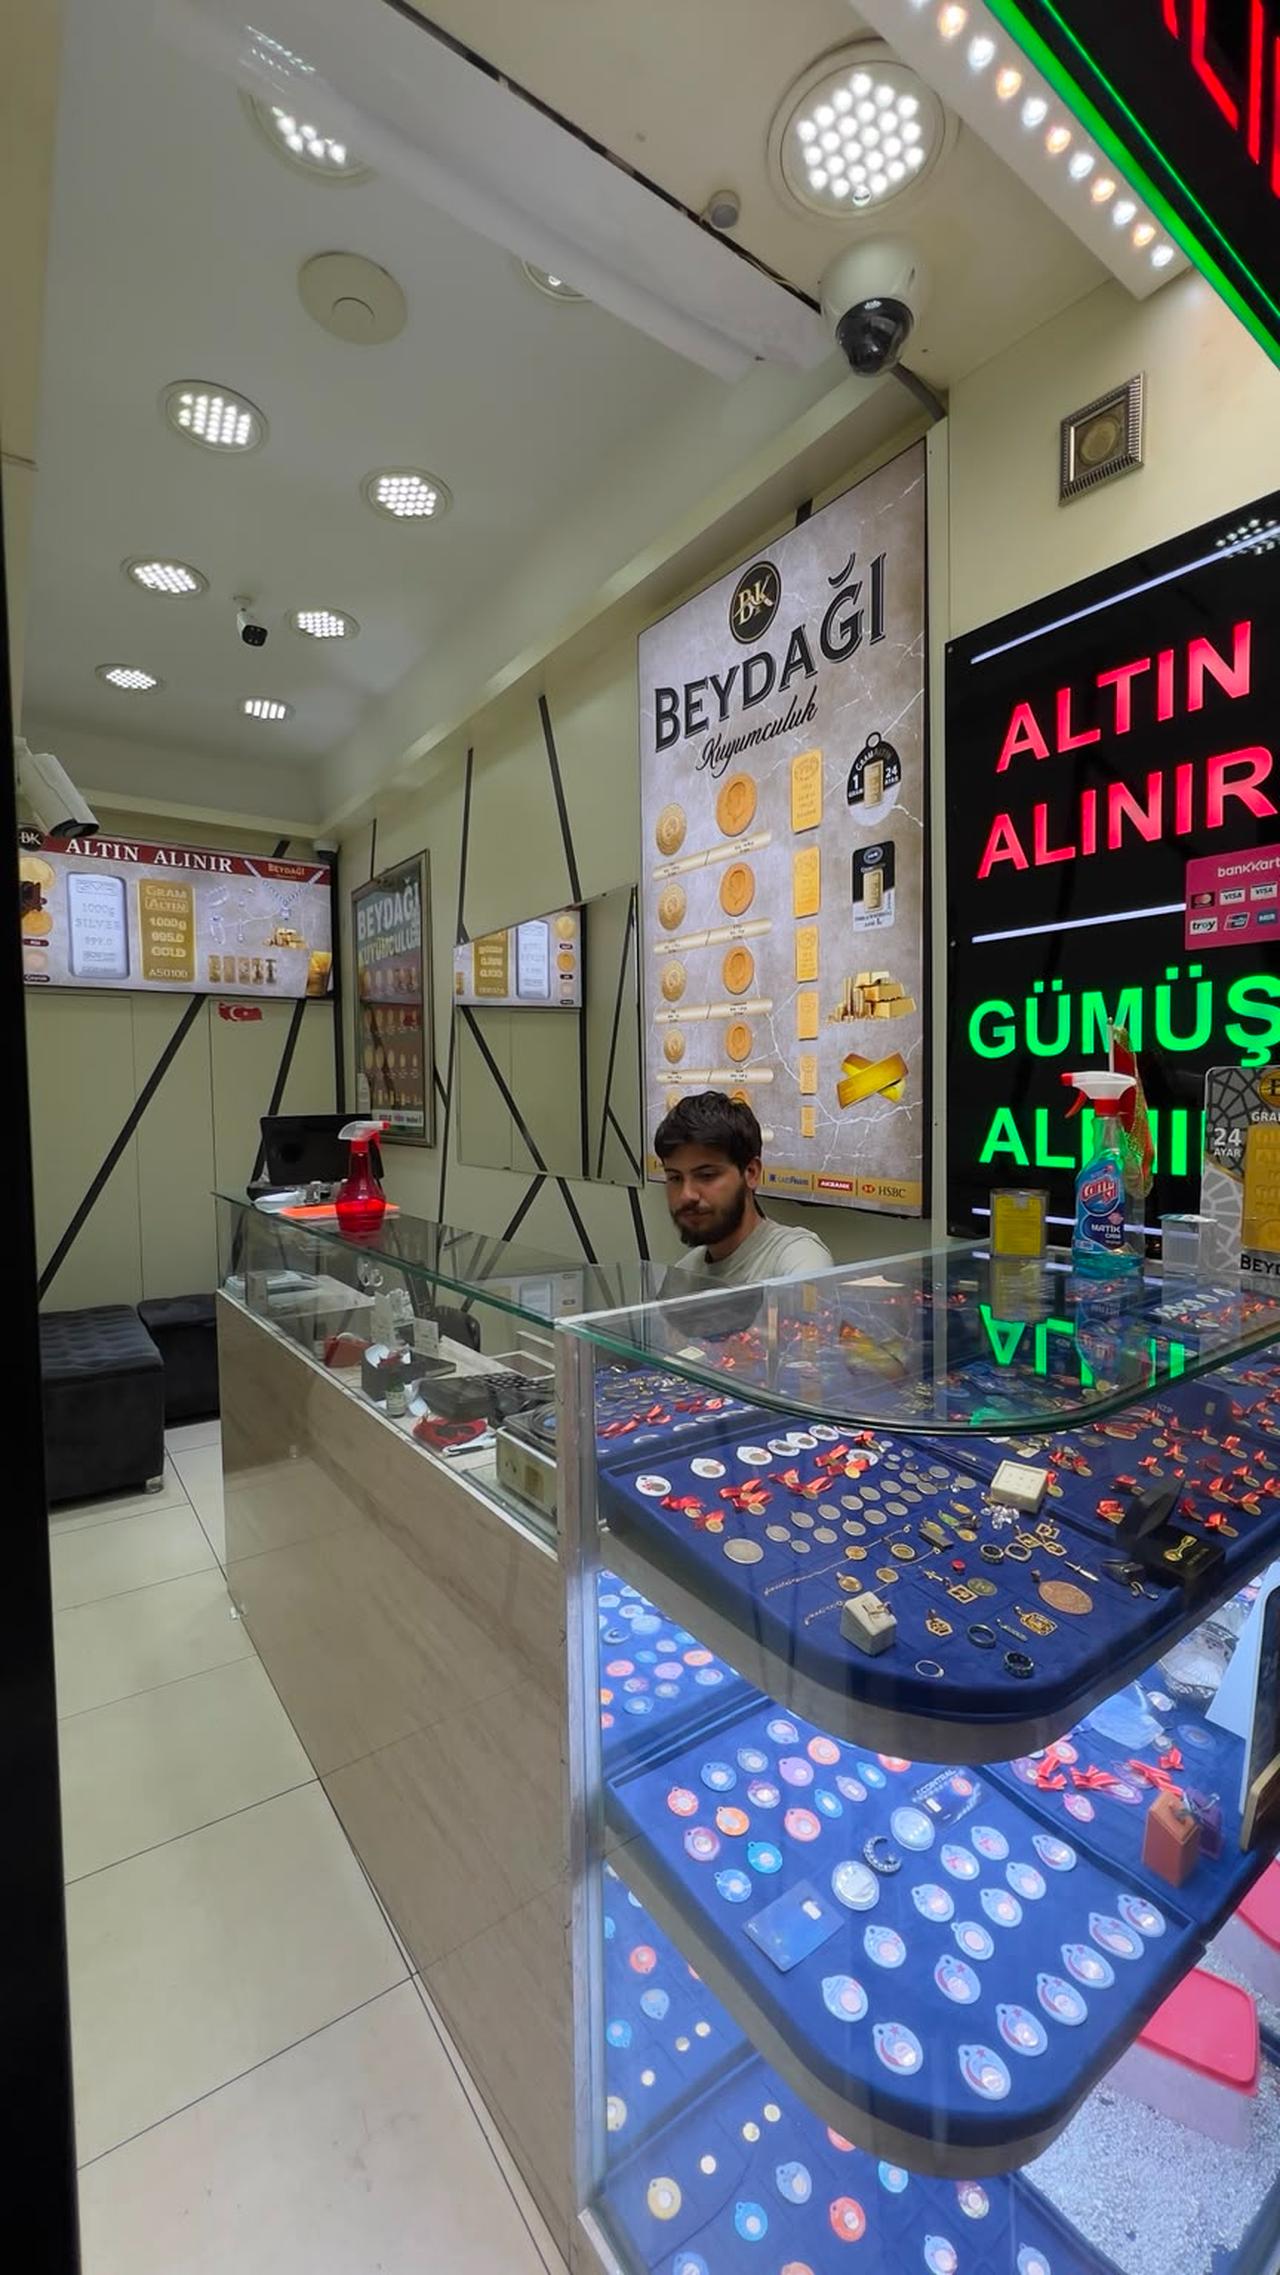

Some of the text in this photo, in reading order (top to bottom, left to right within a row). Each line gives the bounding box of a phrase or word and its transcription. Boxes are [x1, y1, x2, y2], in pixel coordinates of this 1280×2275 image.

[654, 551, 887, 753] BEYDAĞI
[995, 619, 1252, 774] ALTIN
[695, 684, 819, 778] Kuyumculuk
[885, 764, 898, 778] 24
[852, 774, 859, 790] 1
[976, 744, 1279, 880] ALINIR
[65, 838, 233, 873] ALTIN ALINIR
[146, 886, 187, 899] GRAM
[147, 899, 188, 913] ALTIN
[357, 876, 420, 941] BEYDAĞI
[1192, 919, 1216, 931] troy
[151, 947, 187, 958] GOLD
[968, 964, 1280, 1067] GÜMÜŞ
[1213, 1127, 1242, 1147] 24
[1213, 1148, 1242, 1157] AYAR
[877, 1185, 906, 1198] HSBC
